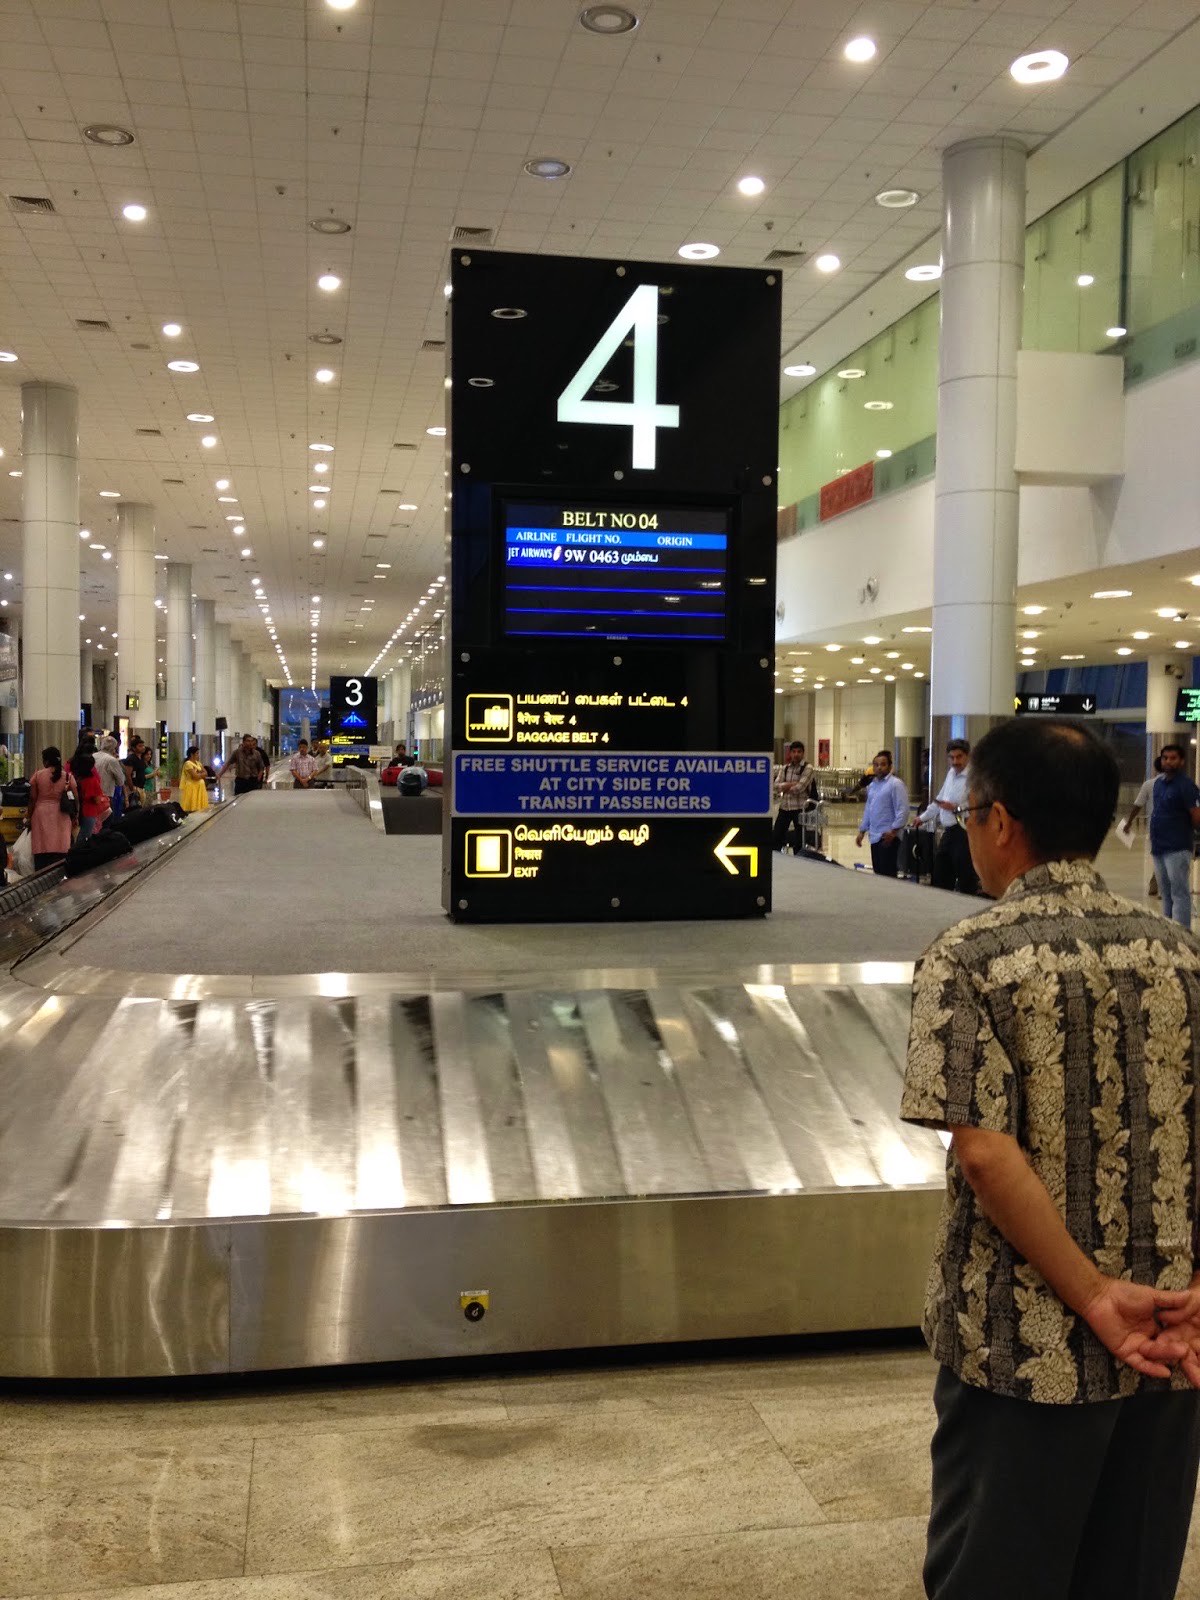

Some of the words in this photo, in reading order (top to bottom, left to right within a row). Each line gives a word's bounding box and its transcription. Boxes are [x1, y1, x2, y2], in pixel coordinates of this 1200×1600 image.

[557, 284, 680, 470] 4
[562, 511, 607, 527] BELT
[611, 513, 636, 528] NO
[638, 514, 658, 529] 04
[516, 531, 557, 542] AIRLINE
[566, 533, 603, 544] FLIGHT
[605, 535, 622, 545] NO.
[657, 537, 693, 546] ORIGIN
[508, 547, 519, 560] JET
[520, 547, 552, 558] AIRWAYS
[564, 549, 587, 562] 9W
[589, 550, 620, 564] 0463
[345, 679, 363, 706] 3
[680, 696, 688, 707] 4
[569, 715, 577, 726] 4
[516, 732, 570, 743] BAGGAGE
[571, 732, 599, 743] BELT
[601, 732, 609, 744] 4
[460, 758, 505, 772] FREE
[511, 758, 591, 773] SHUTTLE
[596, 759, 669, 773] SERVICE
[674, 759, 767, 774] AVAILABLE
[539, 777, 562, 791] AT
[566, 777, 608, 791] CITY
[612, 777, 652, 791] SIDE
[657, 778, 691, 792] FOR
[518, 796, 594, 810] TRANSIT
[599, 796, 711, 811] PASSENGERS
[514, 824, 614, 846] வெளியேறும்
[618, 824, 650, 846] வழி
[513, 867, 538, 878] EXIT
